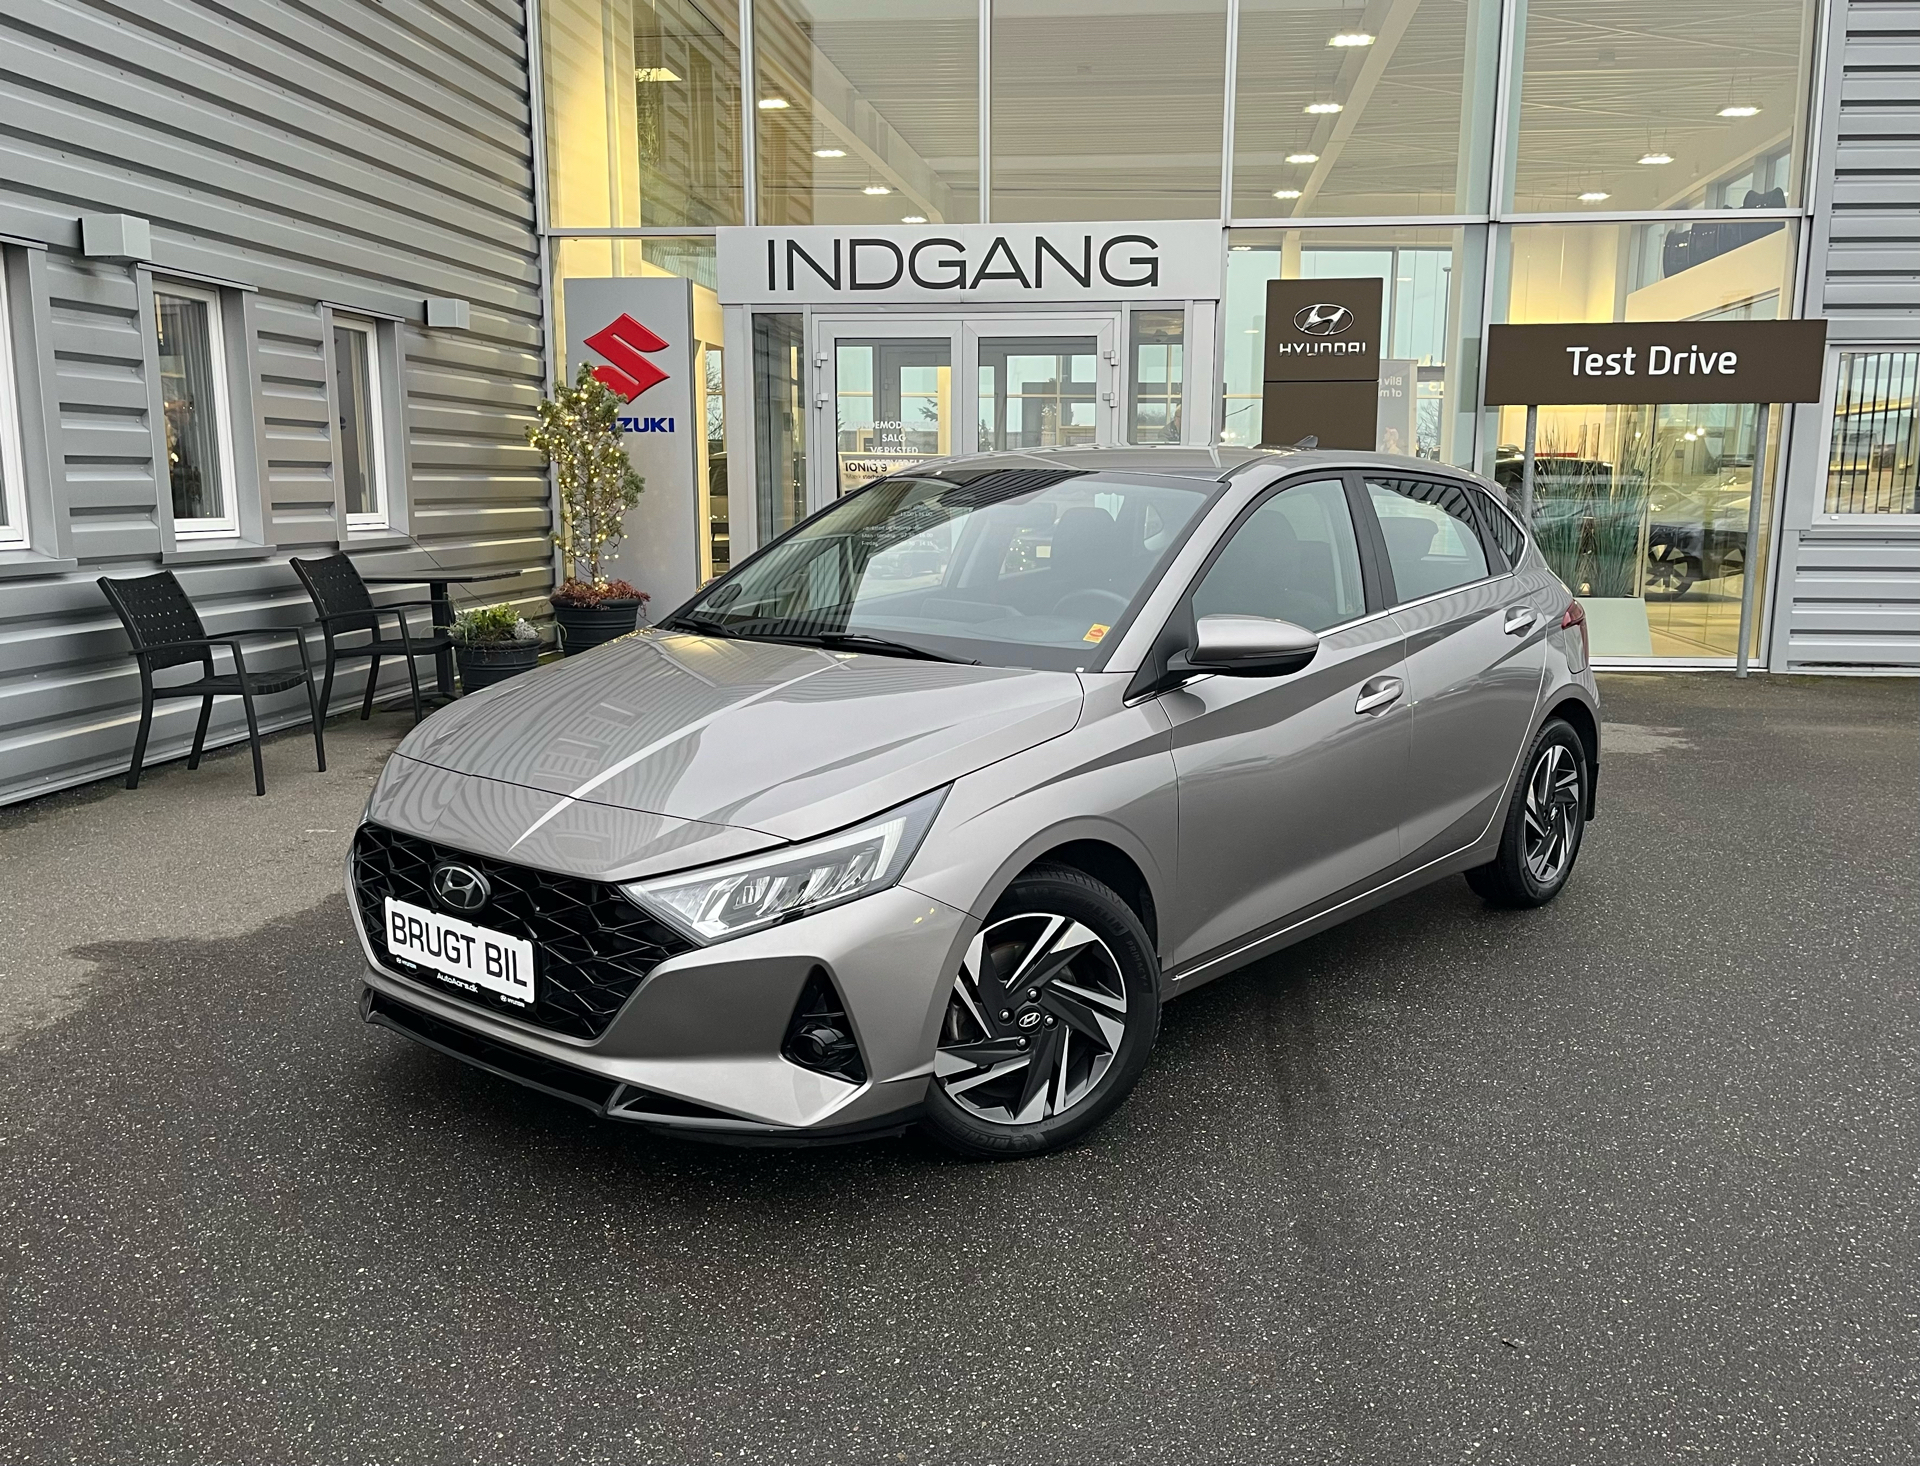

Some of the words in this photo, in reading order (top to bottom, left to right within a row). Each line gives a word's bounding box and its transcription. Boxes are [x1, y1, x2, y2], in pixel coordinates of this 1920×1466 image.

[767, 234, 1159, 291] INDGANG
[1279, 342, 1366, 357] HYUNDAI
[1566, 346, 1636, 376] Test
[1648, 344, 1738, 375] Drive
[608, 417, 675, 433] ZUKI
[881, 433, 907, 443] SALG
[391, 911, 476, 969] BRUGT
[484, 941, 528, 988] BIL
[1126, 940, 1149, 981] PRIMACY
